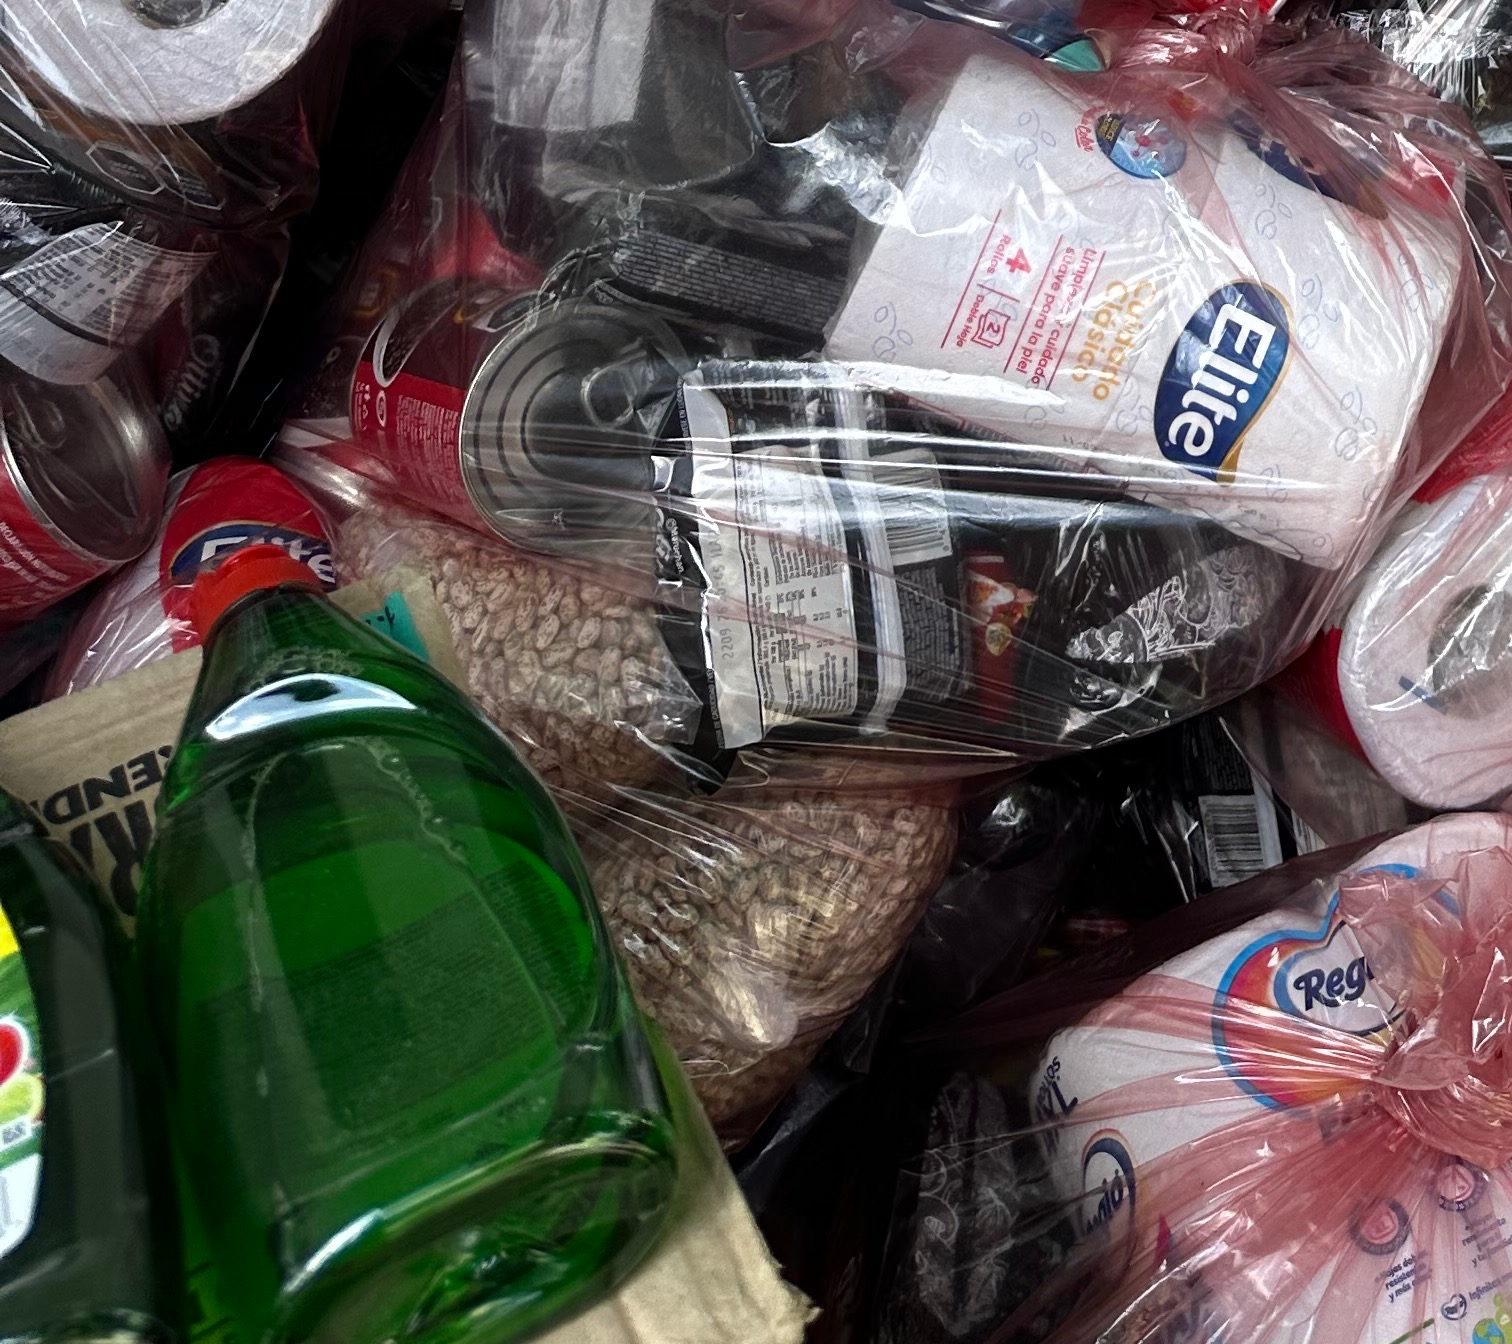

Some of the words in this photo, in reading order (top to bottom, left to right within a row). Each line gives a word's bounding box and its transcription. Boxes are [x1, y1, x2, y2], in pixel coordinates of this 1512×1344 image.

[986, 233, 1012, 275] Rollos
[1006, 247, 1032, 274] 4
[1049, 246, 1076, 293] suave
[989, 322, 1001, 334] 2
[1034, 293, 1056, 332] para
[1017, 350, 1033, 375] piel
[1031, 328, 1062, 386] cuidado
[1168, 302, 1276, 458] Elite
[30, 745, 173, 825] END
[1293, 958, 1374, 1011] Reg
